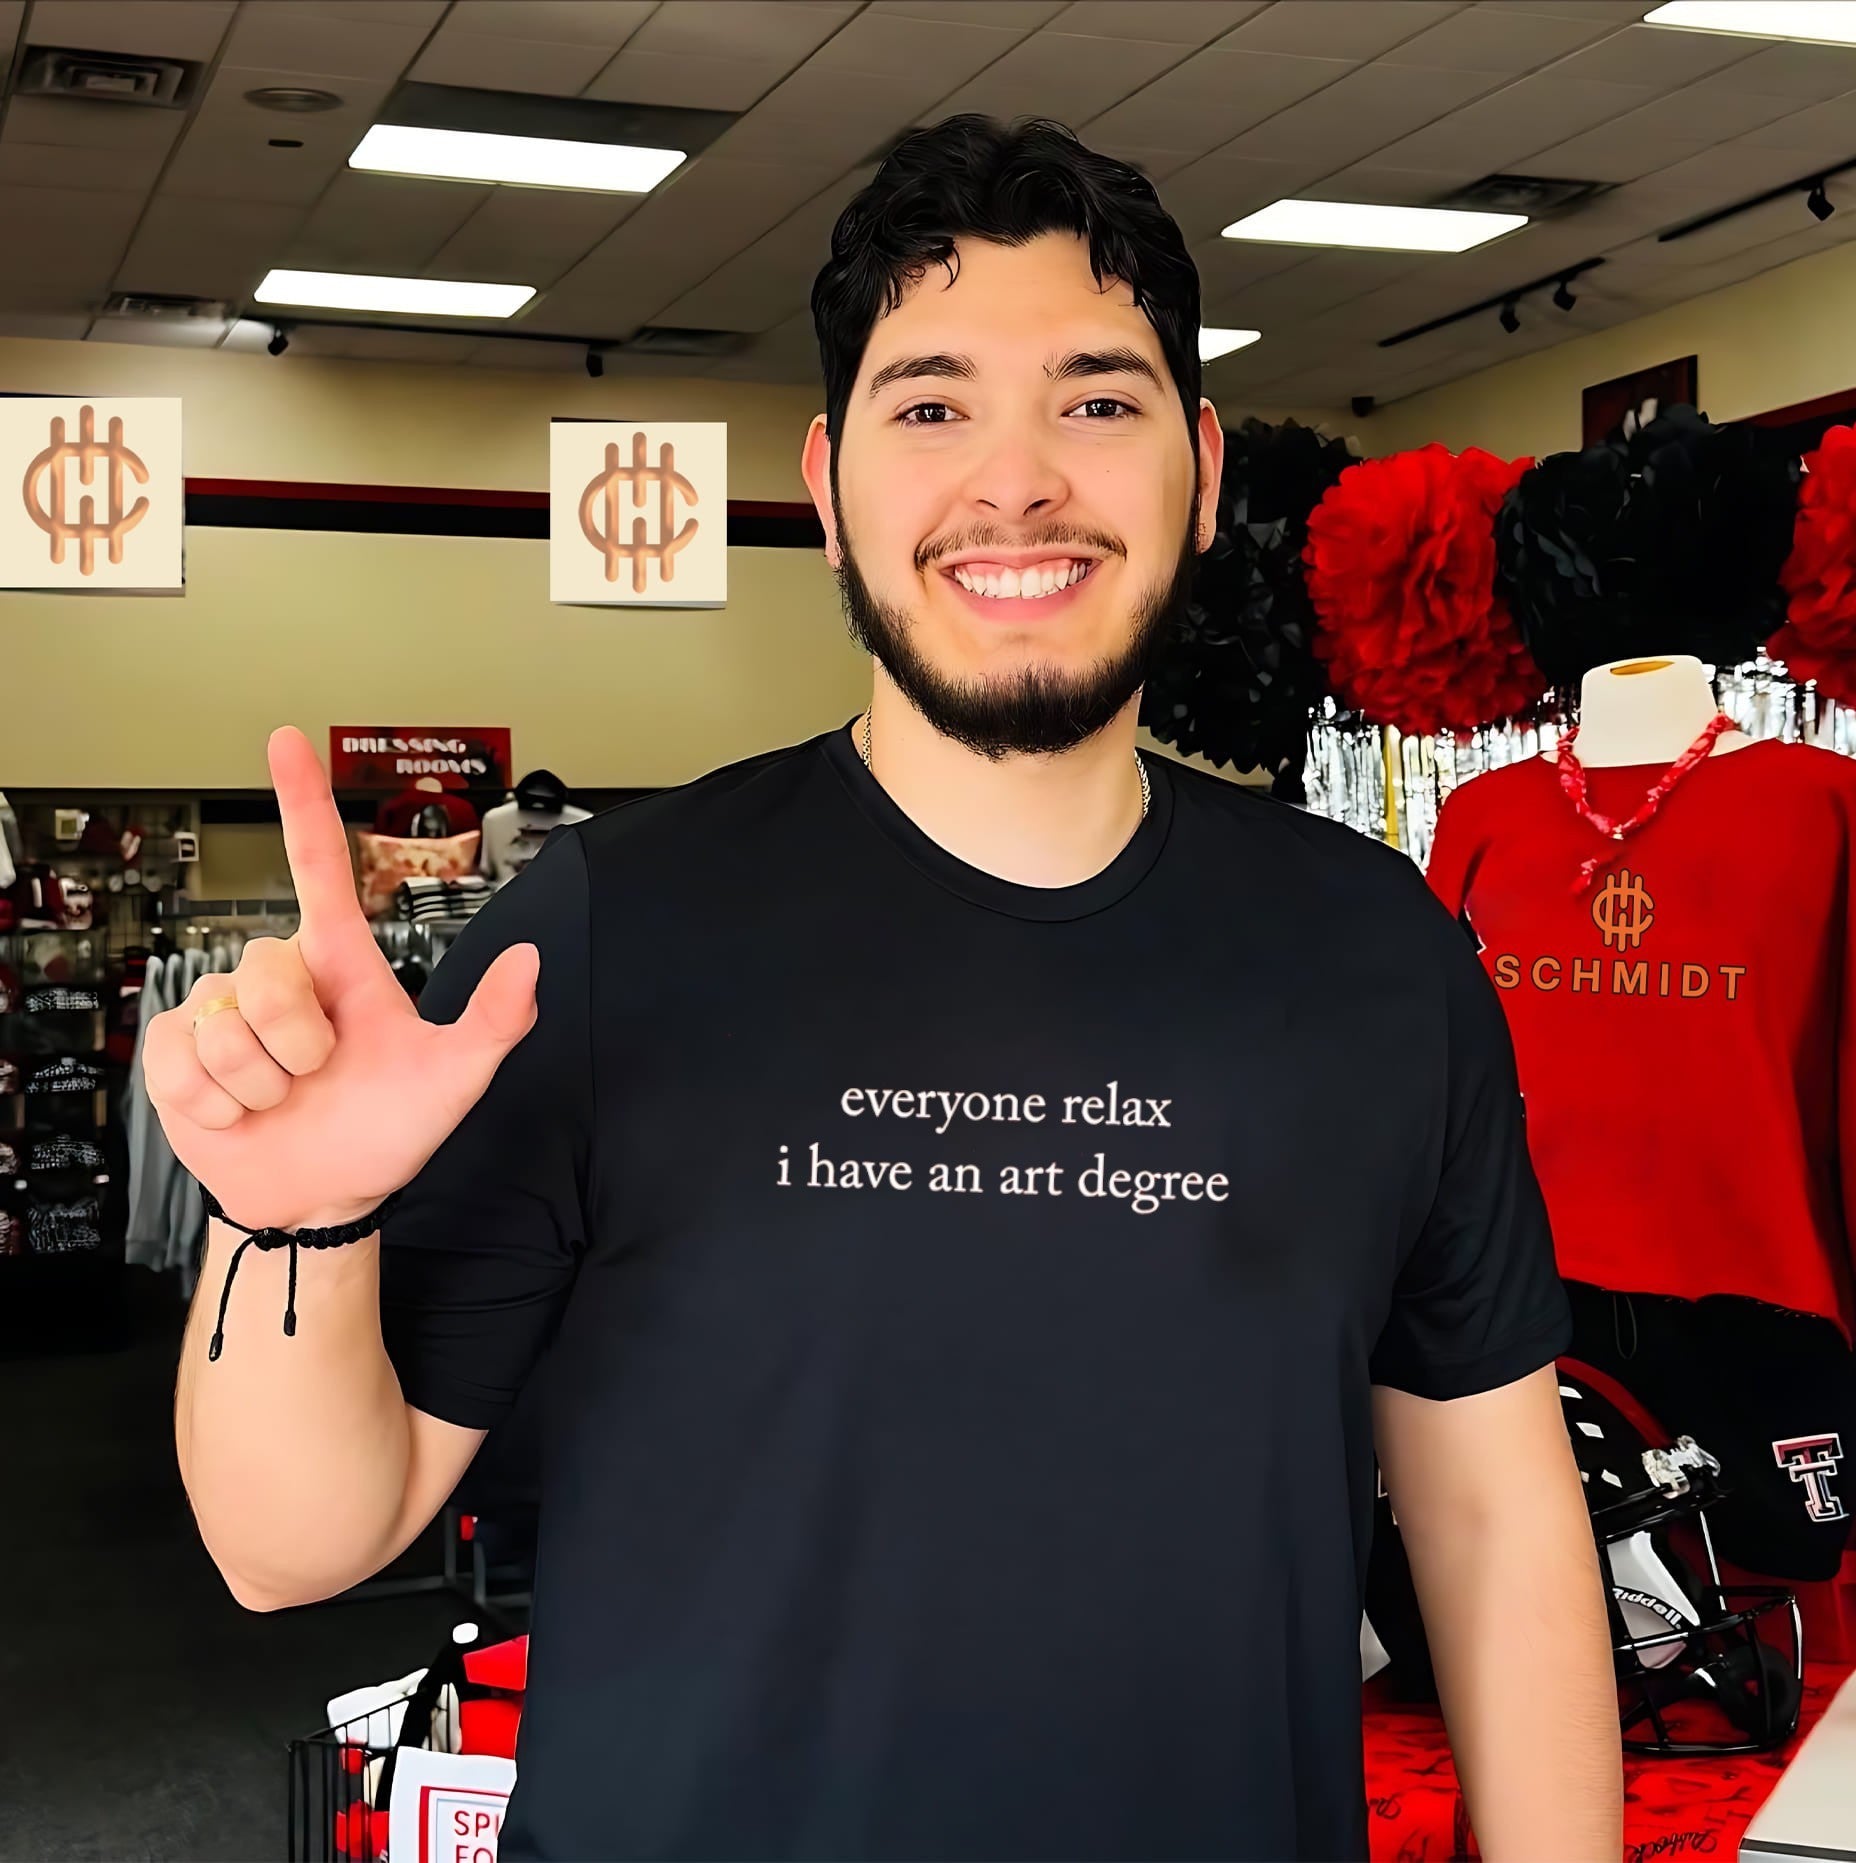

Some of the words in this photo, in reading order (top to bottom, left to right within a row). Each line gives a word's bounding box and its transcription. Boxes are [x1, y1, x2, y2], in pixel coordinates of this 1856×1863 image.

[342, 737, 467, 754] DRESSING
[396, 758, 487, 775] ROOMS
[1494, 954, 1746, 999] SCHMIDT
[840, 1087, 1047, 1135] everyone
[1061, 1080, 1173, 1128] relax
[776, 1144, 792, 1187] i
[806, 1141, 913, 1191] have
[928, 1163, 984, 1194] an
[999, 1161, 1065, 1197] art
[1077, 1152, 1230, 1215] degree
